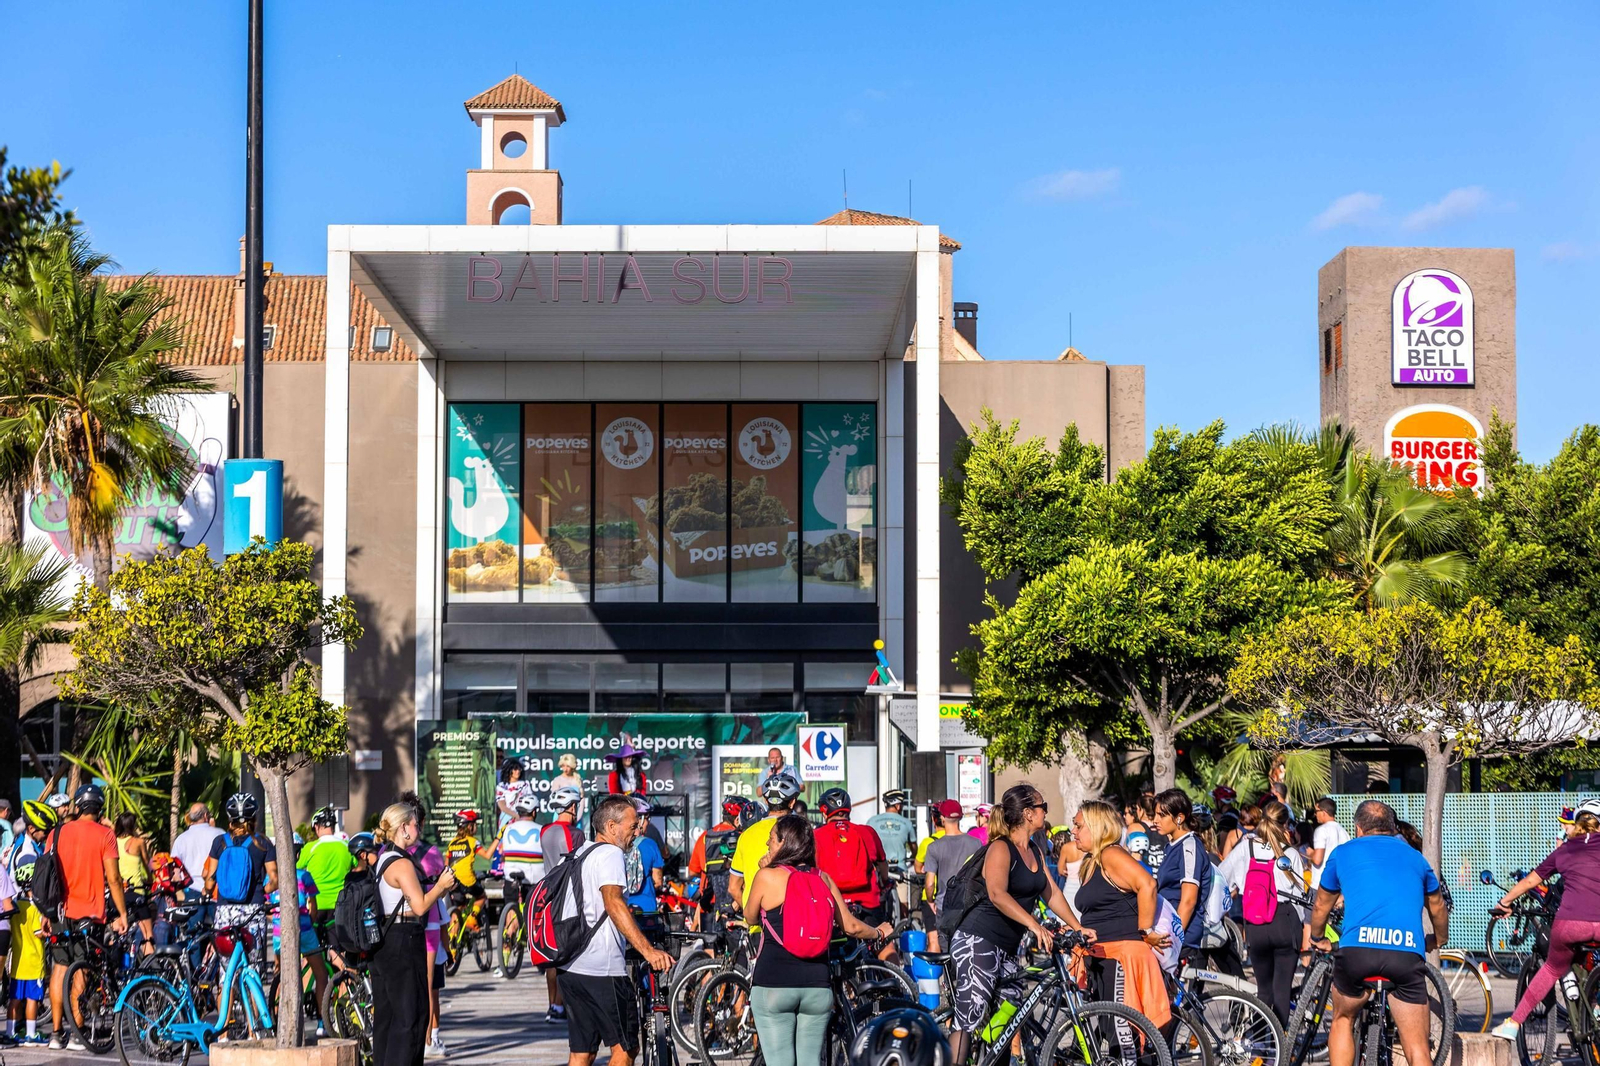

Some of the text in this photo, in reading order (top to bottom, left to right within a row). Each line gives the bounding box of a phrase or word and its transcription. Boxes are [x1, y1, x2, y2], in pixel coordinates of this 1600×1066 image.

[466, 255, 794, 304] BAHIA SUR
[1402, 329, 1464, 347] TACO
[1408, 349, 1465, 366] BELL
[1412, 369, 1455, 382] AUTO
[608, 420, 646, 435] LOUISIANA
[746, 420, 784, 435] LOUISIANA
[1391, 440, 1478, 460] BURGER
[611, 454, 644, 466] KITCHEN
[749, 454, 782, 466] KITCHEN
[233, 470, 268, 541] 1
[433, 732, 480, 741] PREMIOS
[496, 734, 706, 753] mpulsando el deporte
[723, 780, 752, 796] Día
[1358, 926, 1417, 948] EMILIO B.
[993, 984, 1043, 1055] ROCKRIDER
